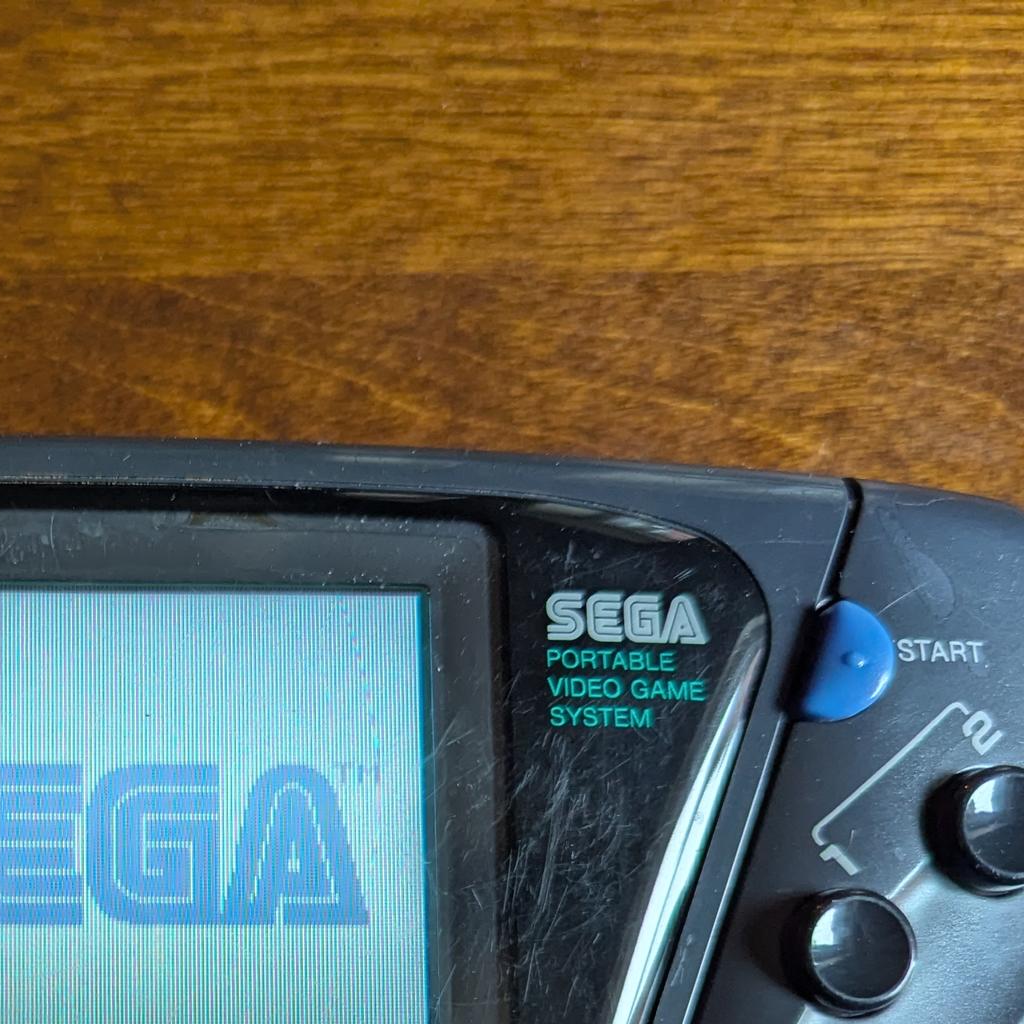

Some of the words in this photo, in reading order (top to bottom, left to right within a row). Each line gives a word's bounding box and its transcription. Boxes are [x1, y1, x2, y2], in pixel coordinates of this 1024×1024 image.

[546, 591, 710, 645] SEGA
[546, 648, 675, 671] PORTABLE
[897, 638, 984, 663] START
[547, 677, 622, 699] VIDEO
[630, 679, 706, 701] GAME
[549, 706, 653, 729] SYSTEM
[962, 710, 1003, 756] 2
[819, 844, 859, 876] 1
